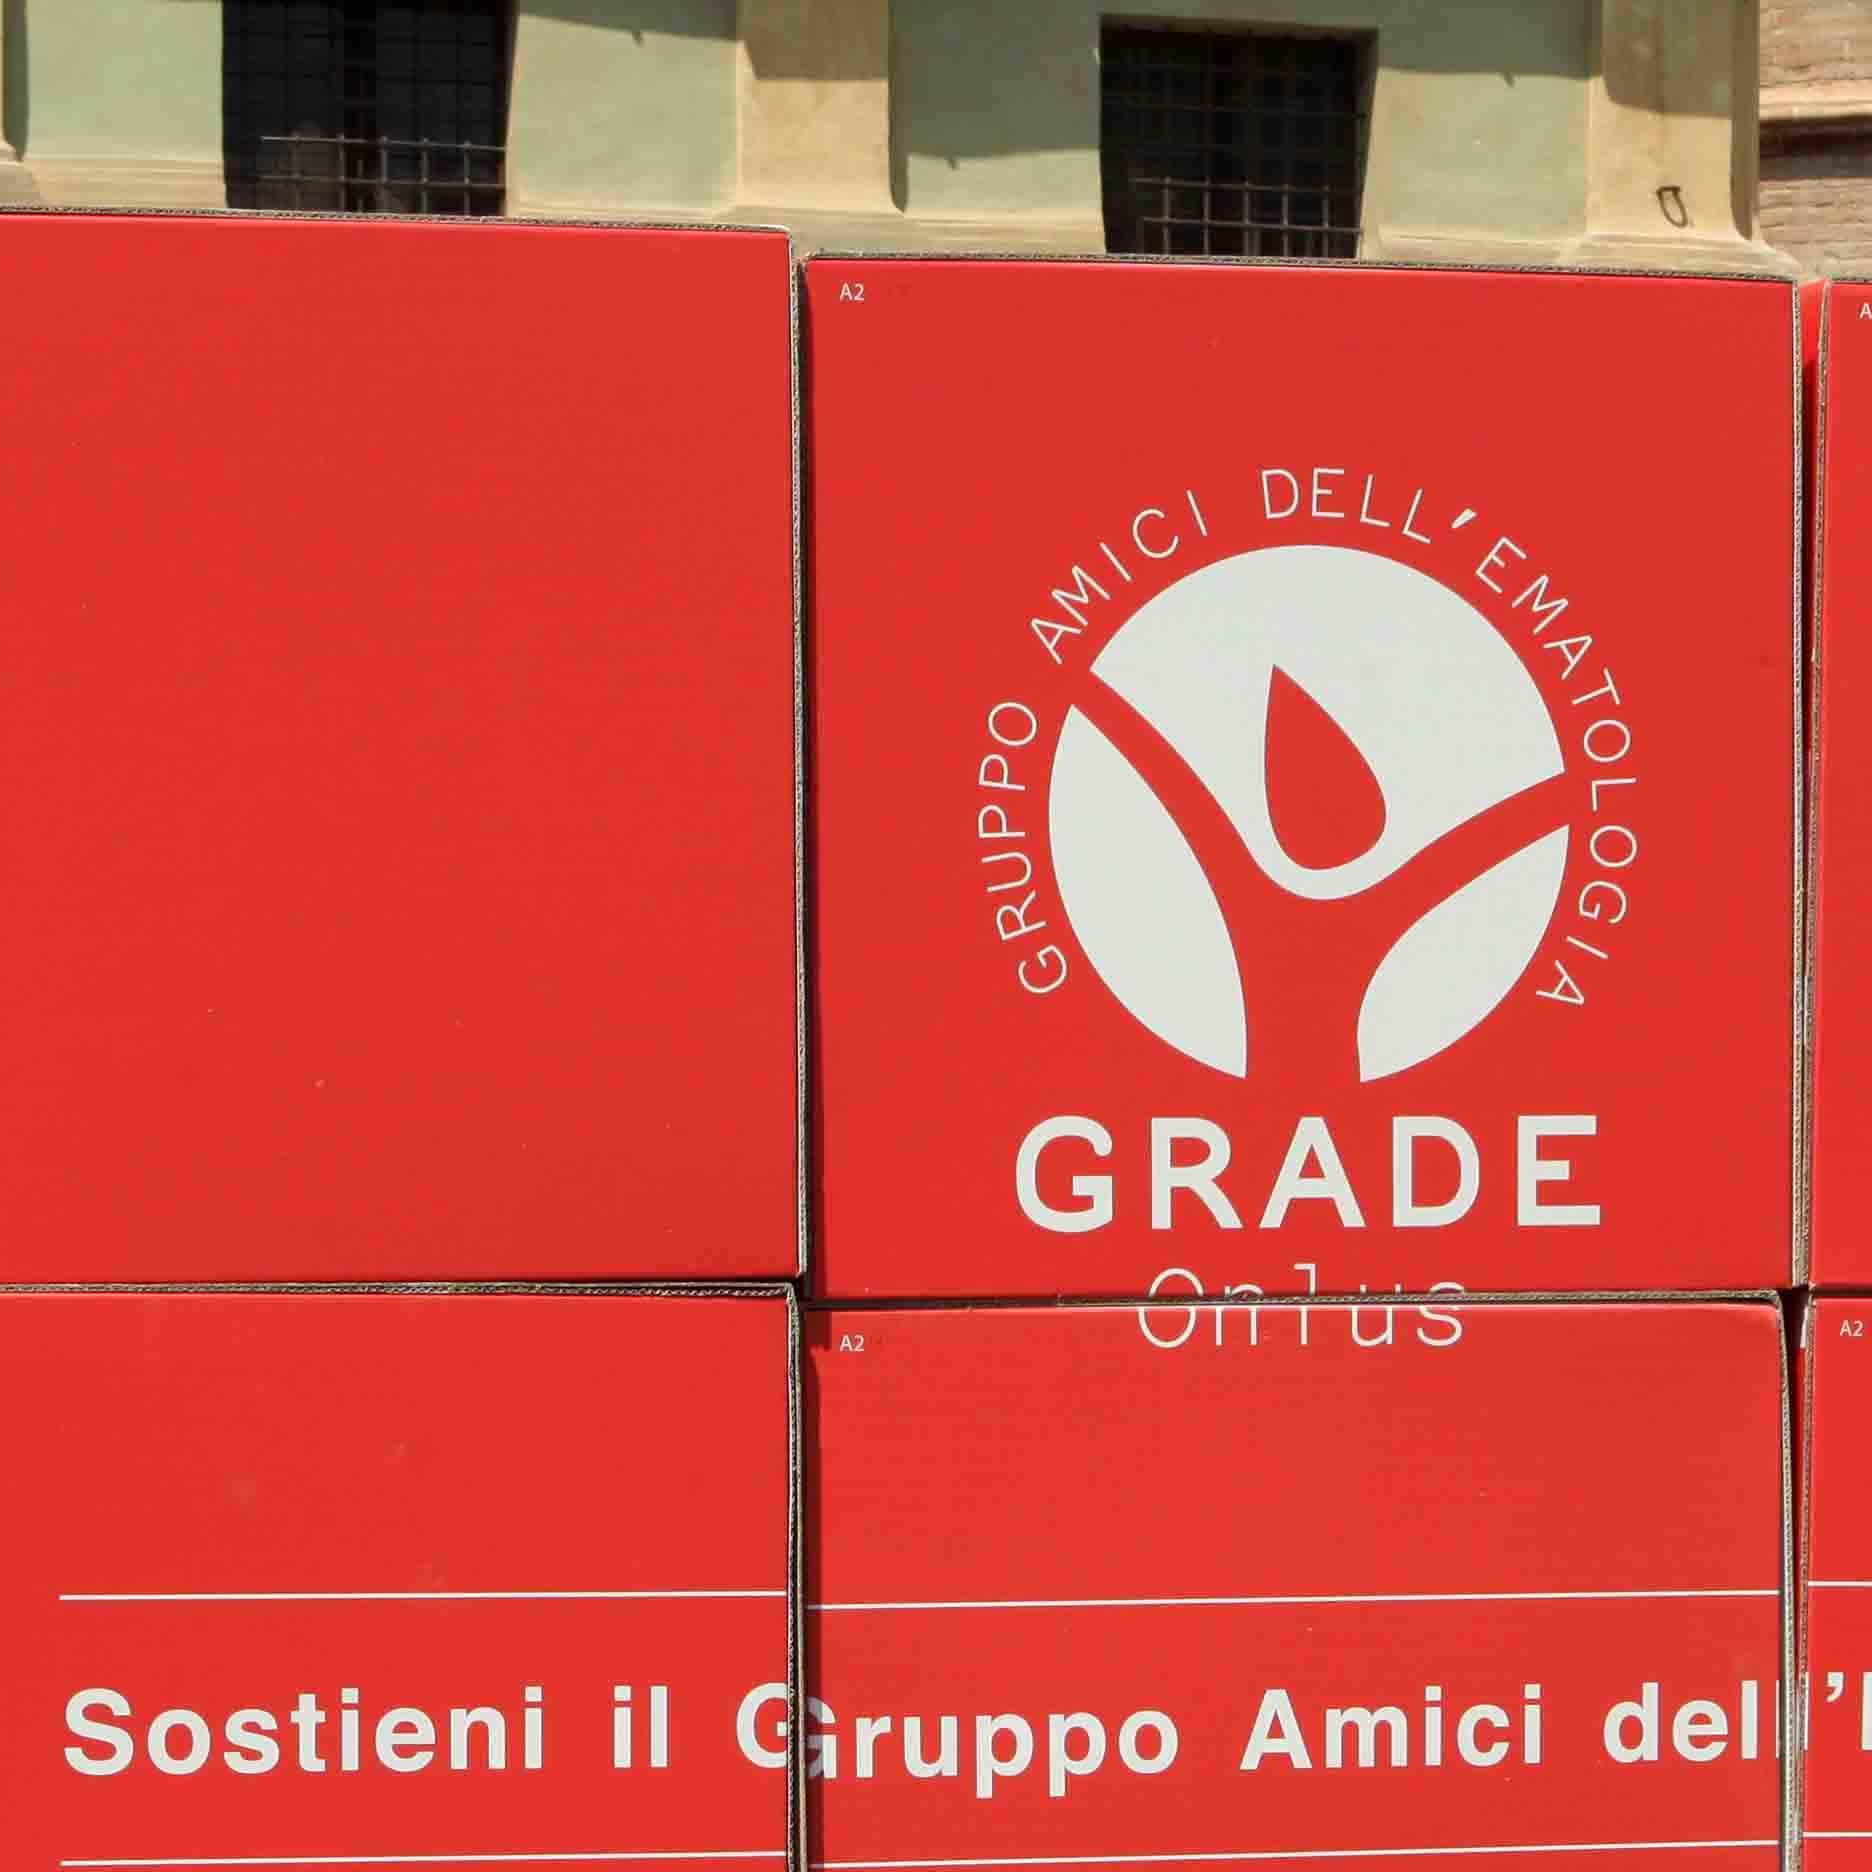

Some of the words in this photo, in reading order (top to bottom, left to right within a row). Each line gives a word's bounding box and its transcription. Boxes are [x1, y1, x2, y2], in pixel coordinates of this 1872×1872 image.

[839, 283, 865, 301] A2
[978, 702, 1068, 994] GRUPPO
[1030, 490, 1208, 664] AMICI
[1015, 1114, 1602, 1234] GRADE
[839, 1334, 865, 1352] A2
[1135, 1262, 1466, 1349] Onlus
[1839, 1319, 1863, 1337] A2
[63, 1685, 544, 1776] Sostieni
[612, 1685, 670, 1768] il
[735, 1681, 1179, 1798] Gruppo
[1239, 1684, 1543, 1770] Amici
